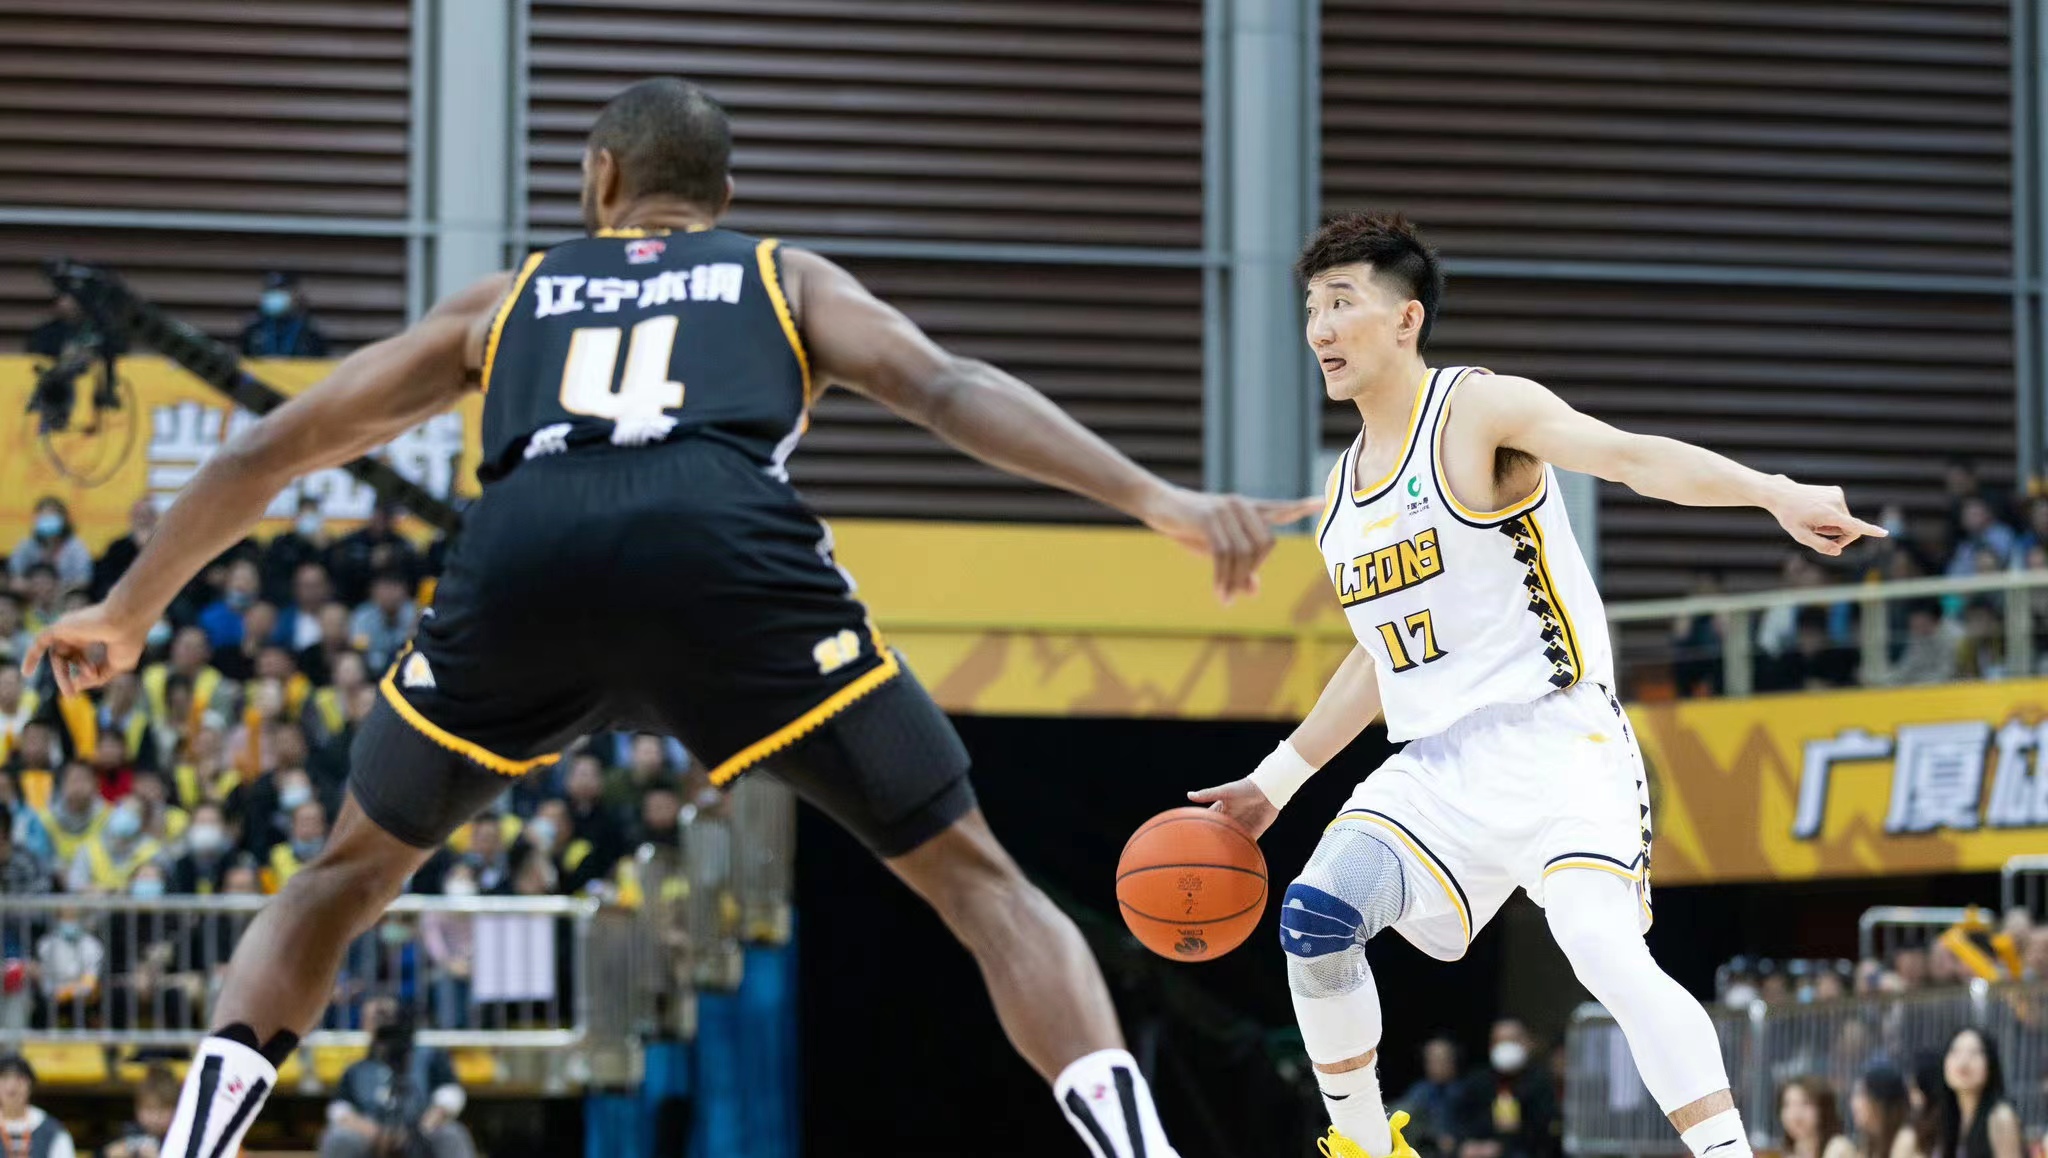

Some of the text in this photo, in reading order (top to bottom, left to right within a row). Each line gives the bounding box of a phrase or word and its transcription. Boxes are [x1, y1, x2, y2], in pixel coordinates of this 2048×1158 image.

[534, 262, 744, 319] 辽宁本钢
[559, 314, 685, 420] 4
[1334, 527, 1445, 608] LIONS
[1375, 608, 1448, 673] 17
